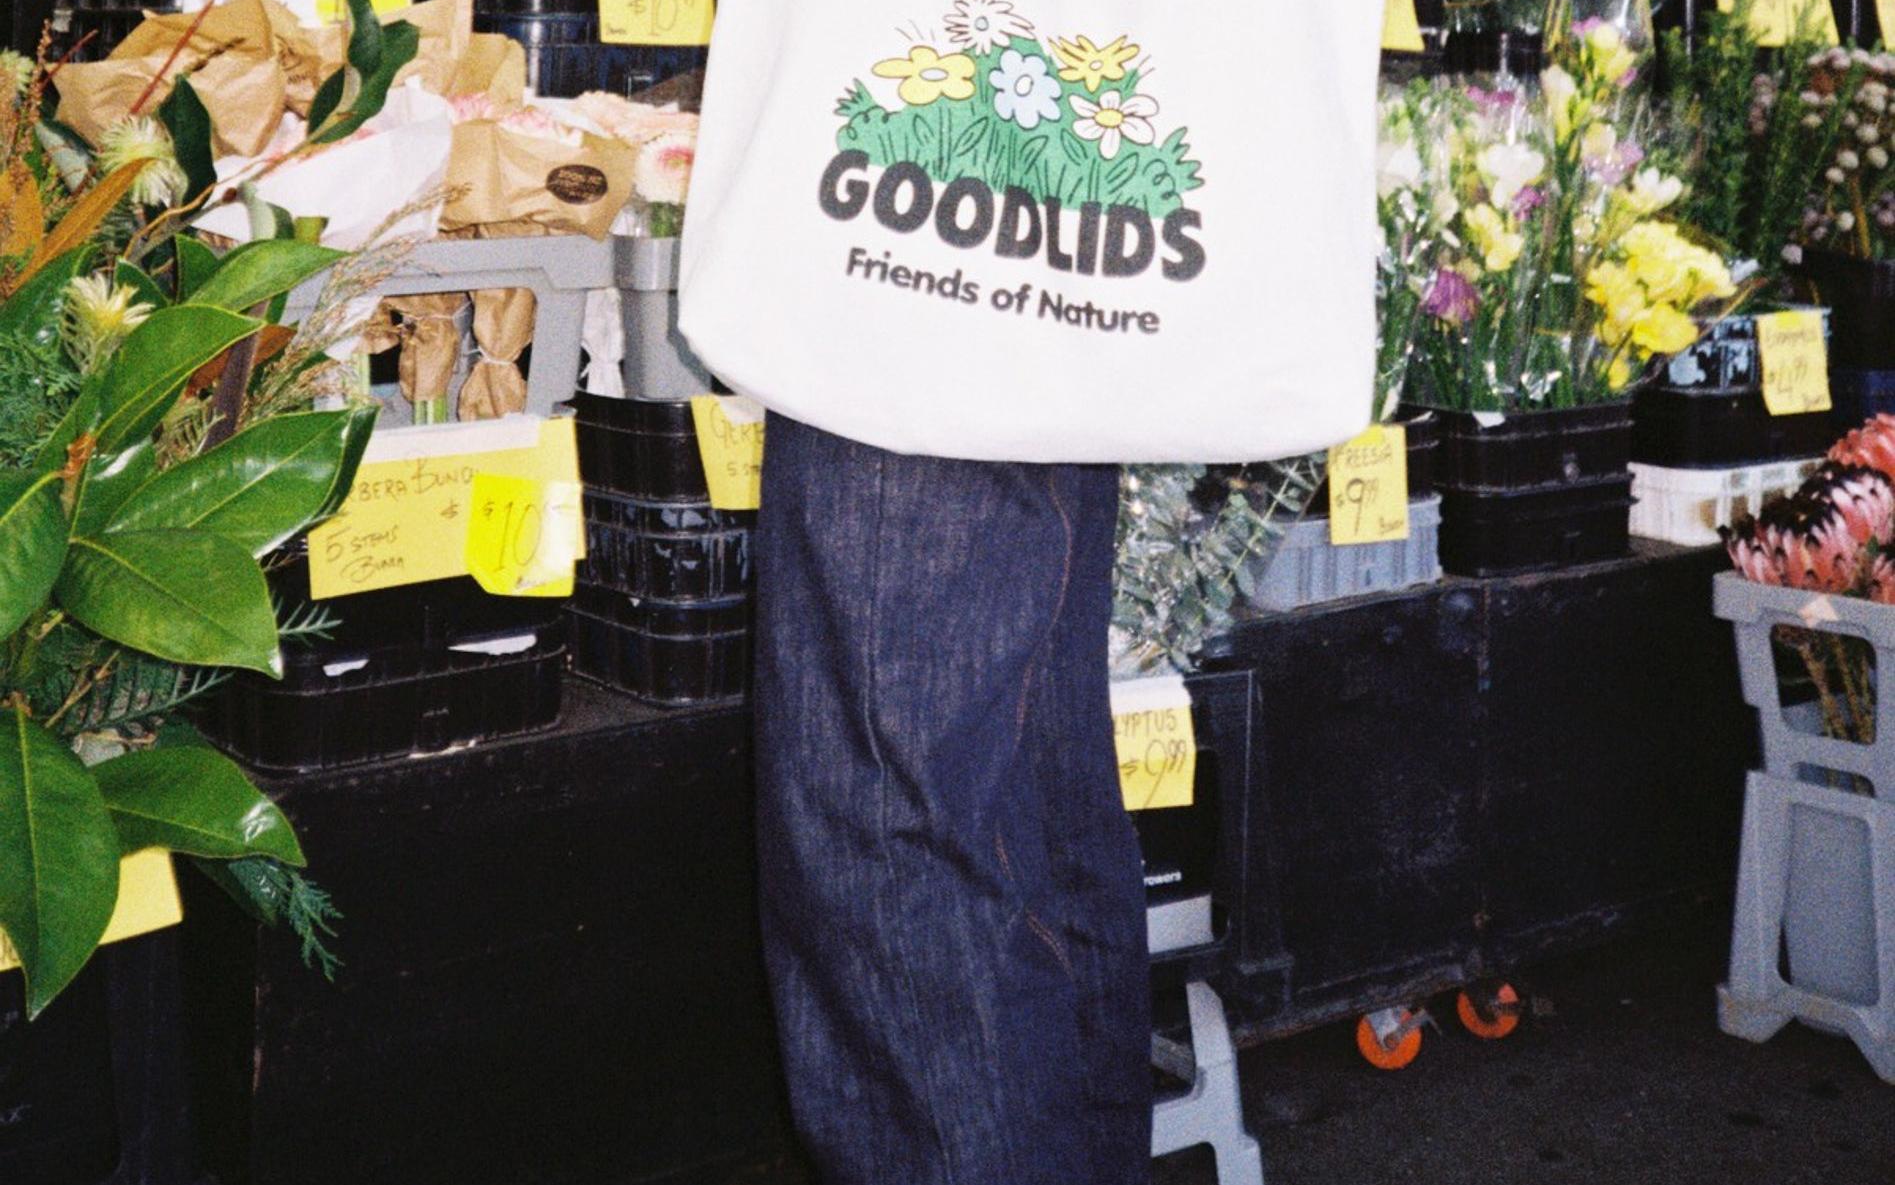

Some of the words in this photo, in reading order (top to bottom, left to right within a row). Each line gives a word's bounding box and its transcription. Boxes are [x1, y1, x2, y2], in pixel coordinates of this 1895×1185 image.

[818, 149, 1206, 282] GOODLIDS
[846, 248, 980, 305] Friends
[991, 284, 1032, 314] of
[1038, 292, 1161, 334] Nature
[326, 526, 352, 563] 5
